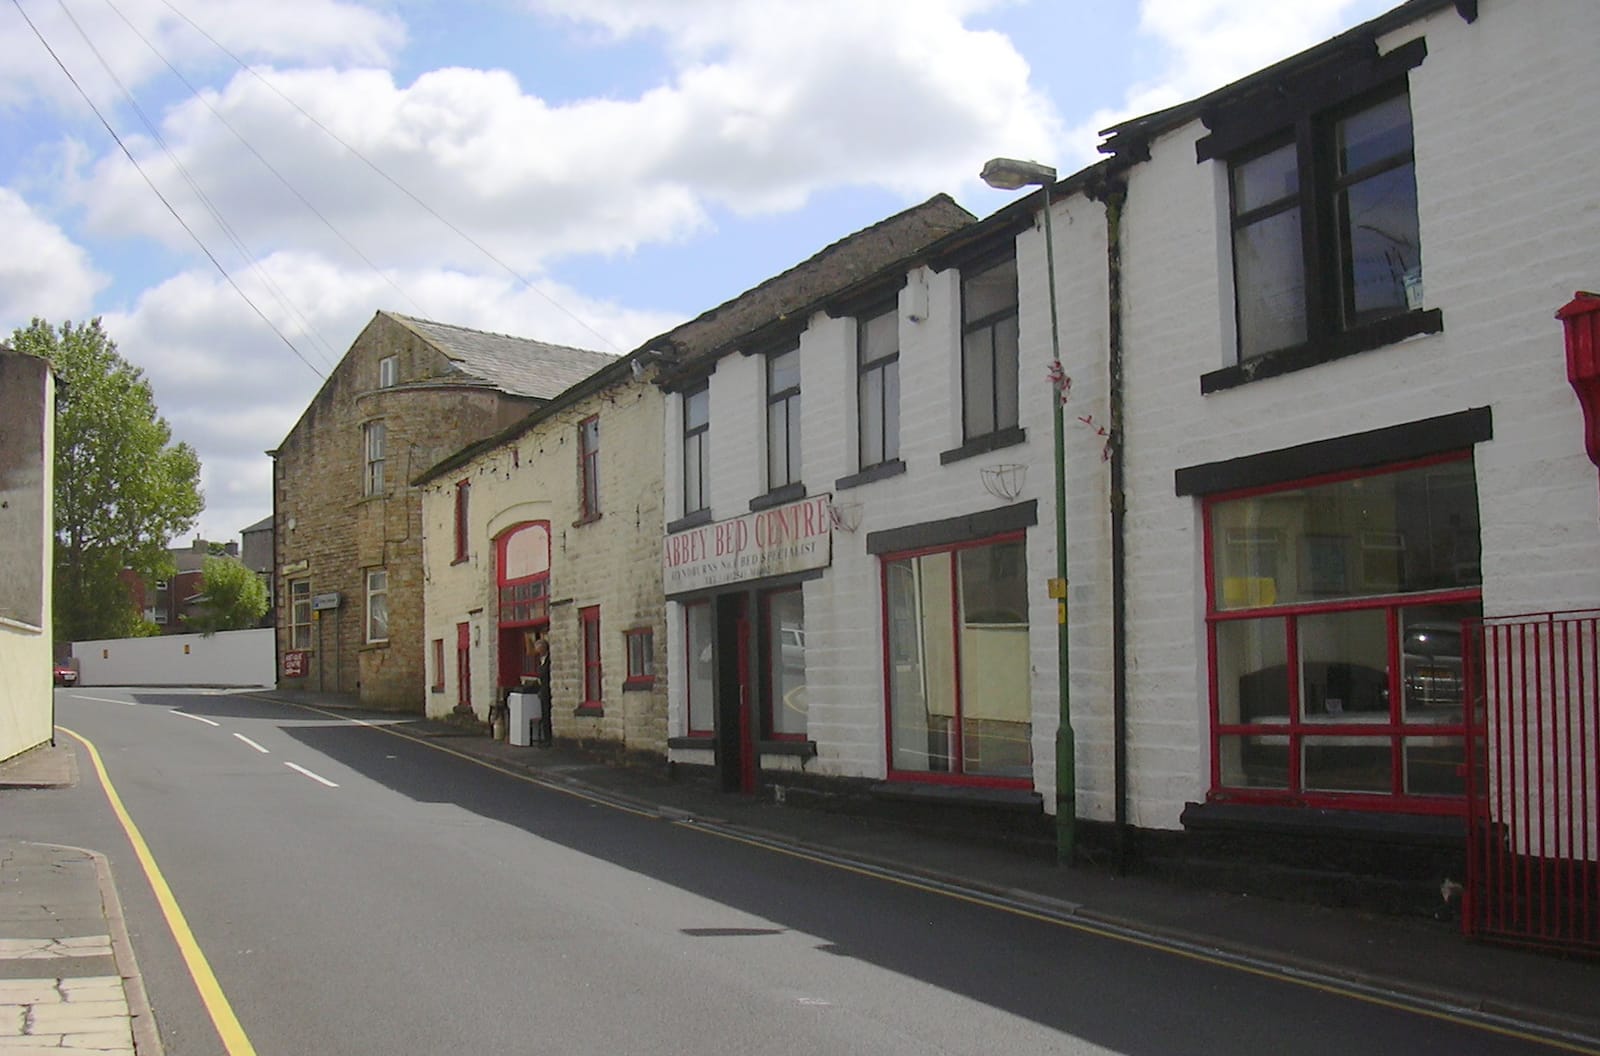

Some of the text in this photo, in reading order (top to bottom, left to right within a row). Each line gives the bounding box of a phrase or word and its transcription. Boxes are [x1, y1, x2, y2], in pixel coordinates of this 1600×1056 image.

[664, 498, 829, 569] ABBEY BED CENTRE
